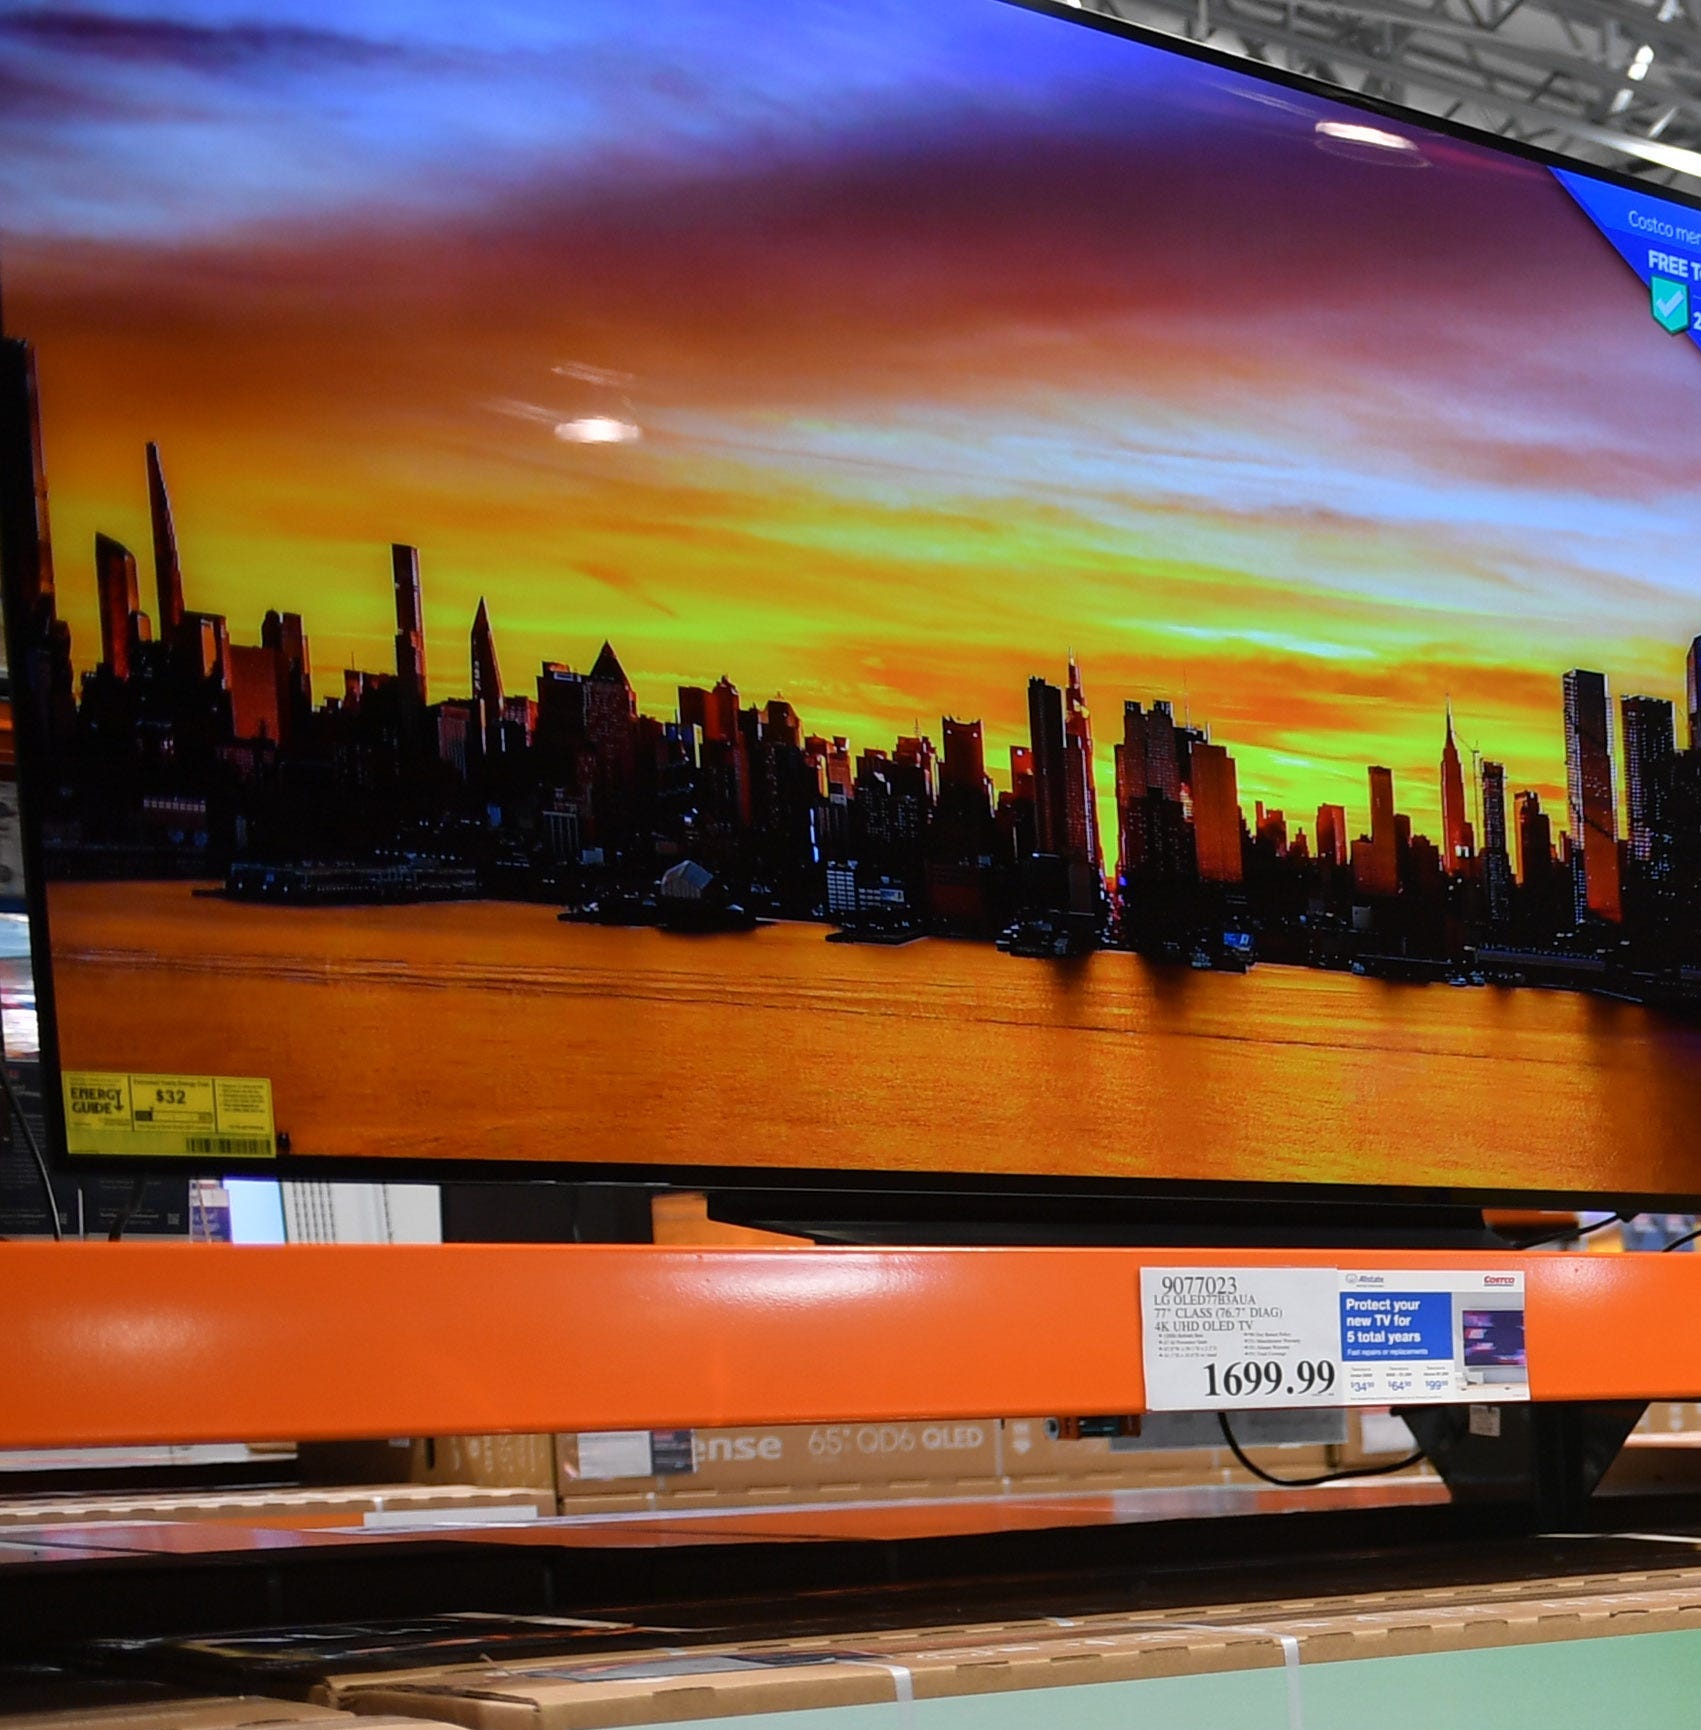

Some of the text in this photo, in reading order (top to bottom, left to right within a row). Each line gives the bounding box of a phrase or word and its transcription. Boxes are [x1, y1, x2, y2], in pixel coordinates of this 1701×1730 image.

[1628, 210, 1674, 238] Costco
[1648, 249, 1688, 278] FREE
[70, 1087, 122, 1101] ENERGY
[156, 1089, 186, 1104] $32
[72, 1102, 112, 1114] GUIDE
[1162, 1276, 1238, 1296] 9077023
[1154, 1295, 1170, 1306] LG
[1346, 1299, 1421, 1313] Protect your
[1175, 1307, 1212, 1320] CLASS
[1249, 1306, 1283, 1319] DIAG)
[1154, 1319, 1254, 1332] 4K UHD OLED TV
[1346, 1314, 1411, 1328] new TV for
[1346, 1331, 1421, 1345] 5 total years
[1204, 1360, 1336, 1397] 1699.99
[696, 1431, 782, 1461] ense
[922, 1426, 983, 1451] QLED
